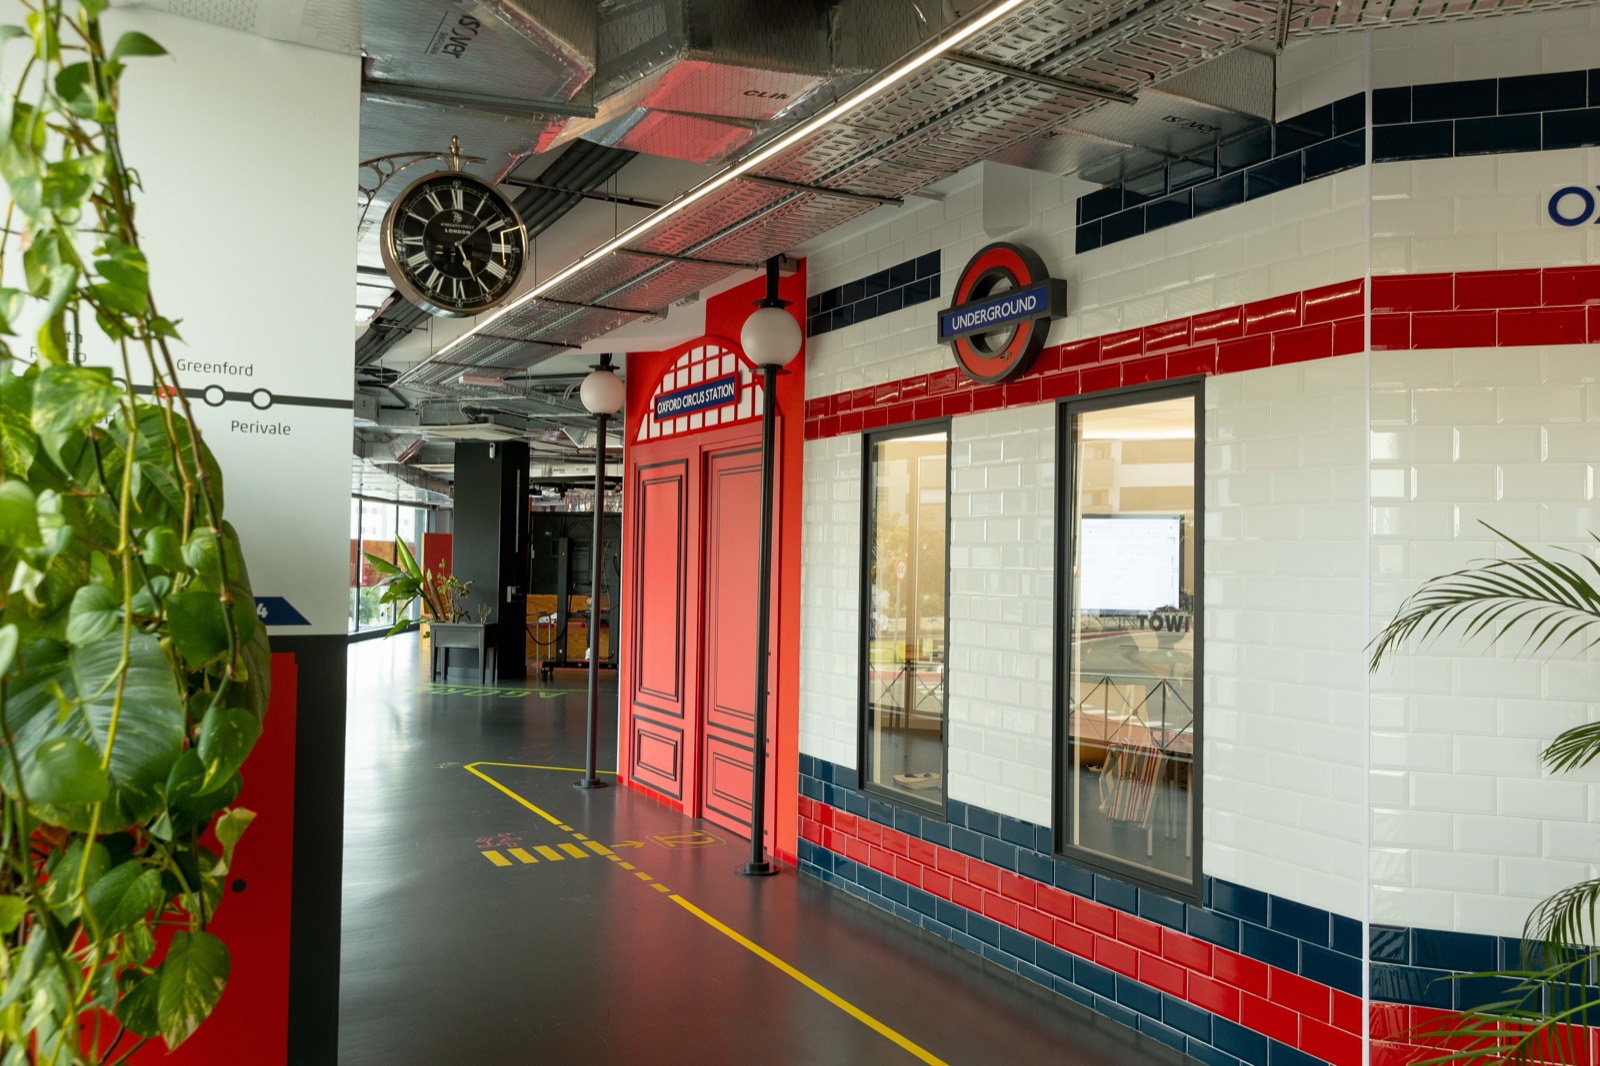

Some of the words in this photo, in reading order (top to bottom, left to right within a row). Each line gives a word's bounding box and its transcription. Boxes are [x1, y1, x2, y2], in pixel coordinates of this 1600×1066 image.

[1548, 186, 1600, 227] O
[952, 295, 1037, 331] UNDERGROUND
[176, 358, 254, 377] Greenford
[657, 397, 681, 414] OXFORD
[682, 390, 705, 408] CIRCUS
[705, 382, 735, 402] STATION
[231, 420, 291, 435] Perivale
